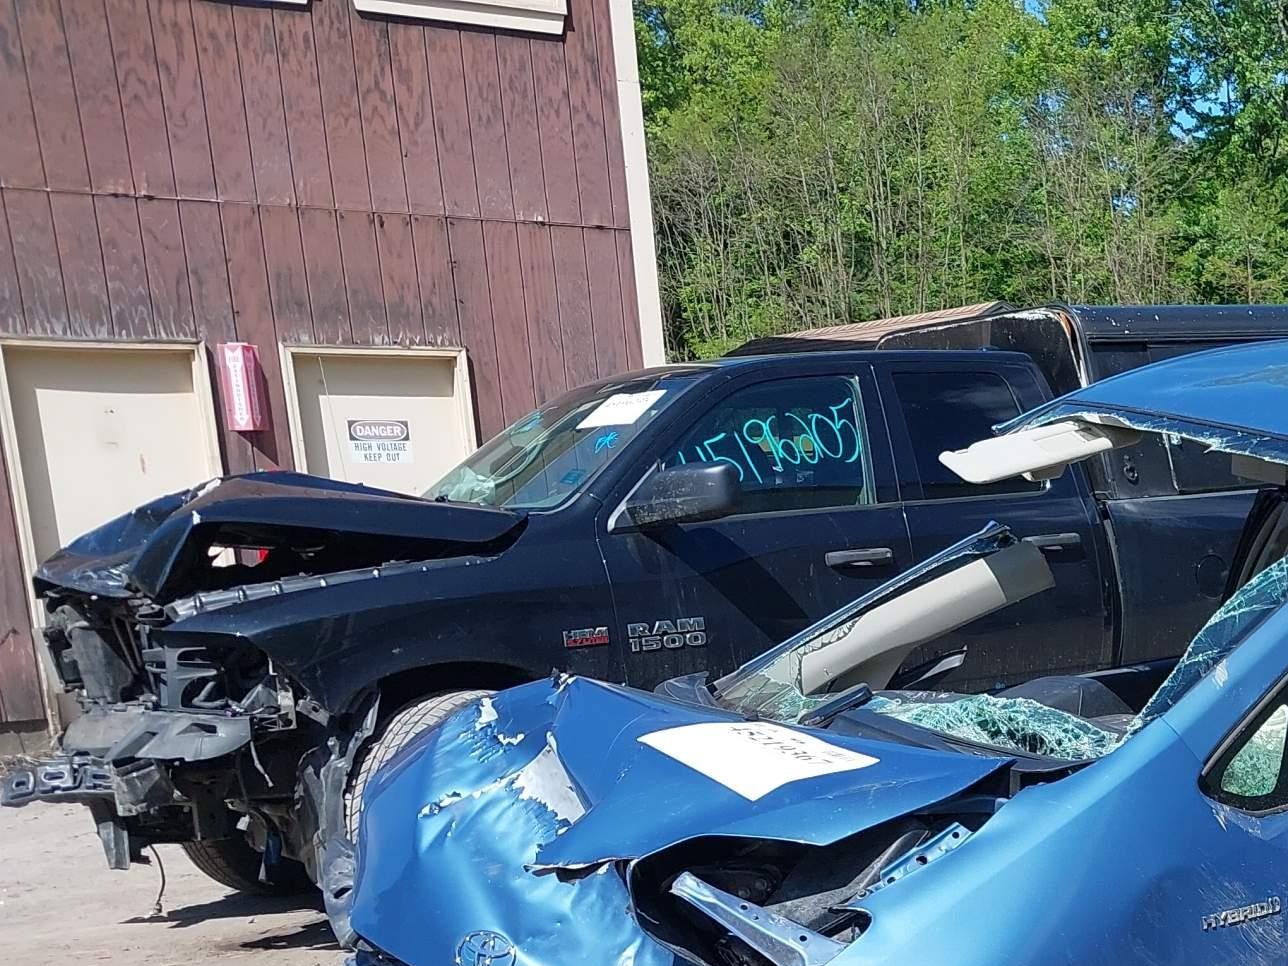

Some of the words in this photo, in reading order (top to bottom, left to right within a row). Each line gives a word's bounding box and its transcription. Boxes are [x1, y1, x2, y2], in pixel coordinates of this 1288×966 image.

[355, 425, 402, 437] DANGER
[354, 442, 373, 452] HIGH
[376, 442, 408, 452] VOLTAGE
[363, 452, 382, 462] KEEP
[386, 452, 400, 462] OUT
[627, 616, 706, 637] RAM
[629, 631, 707, 652] 1500
